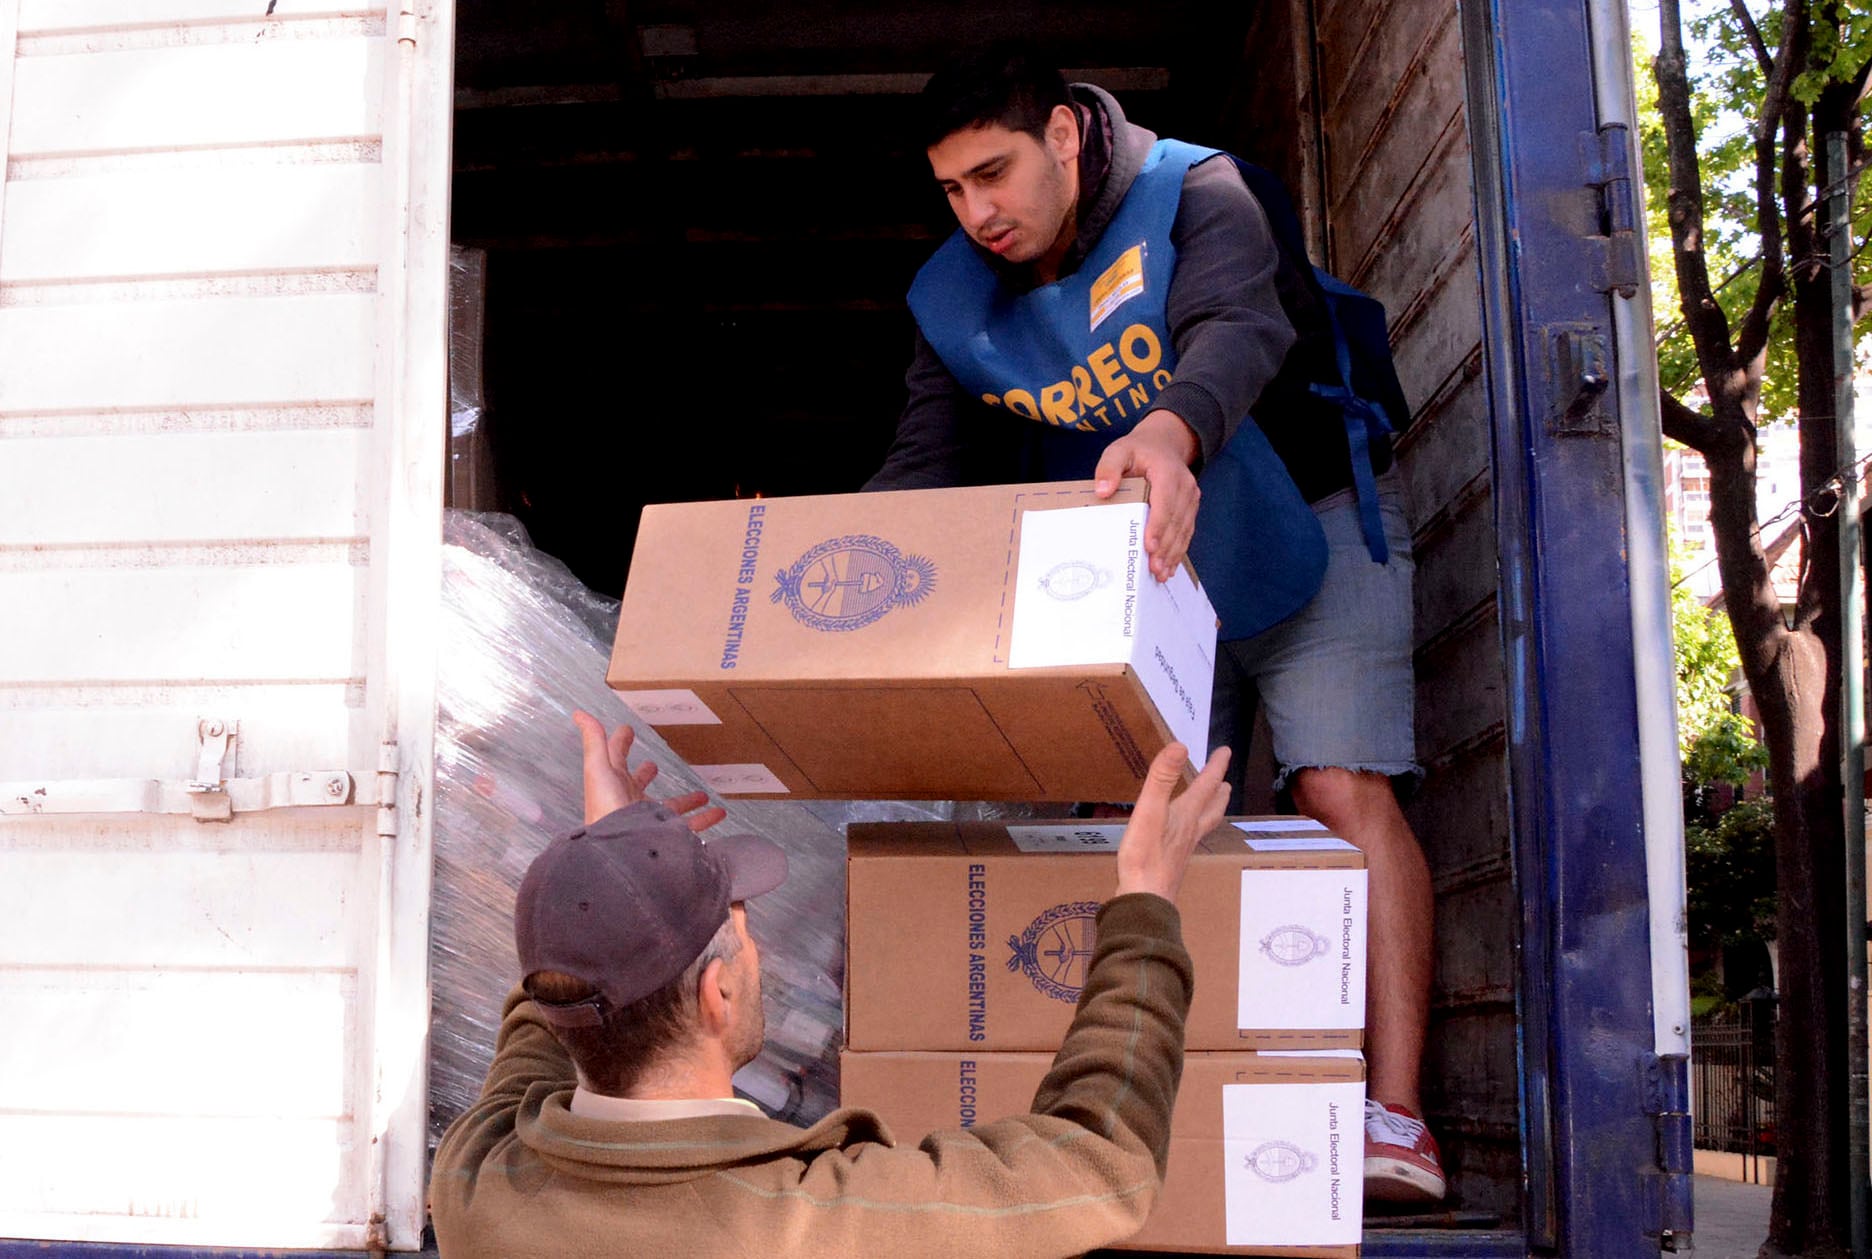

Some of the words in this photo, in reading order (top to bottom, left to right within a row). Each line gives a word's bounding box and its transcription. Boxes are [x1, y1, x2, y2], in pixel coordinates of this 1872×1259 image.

[1076, 369, 1173, 432] NTINO
[737, 505, 766, 584] ELECCIONES
[1128, 519, 1140, 547] Junta
[1126, 549, 1138, 591] Electoral
[720, 587, 751, 670] ARGENTINAS
[1123, 594, 1136, 637] Nacional
[968, 863, 986, 950] ELECCIONES
[1343, 886, 1353, 914] Junta
[1342, 917, 1352, 960] Electoral
[968, 953, 986, 1042] ARGENTINAS
[1340, 962, 1351, 1005] Nacional
[959, 1060, 977, 1128] ELECCION
[1329, 1101, 1339, 1130] Junta
[1329, 1133, 1340, 1176] Electoral
[1330, 1178, 1341, 1221] Nacional
